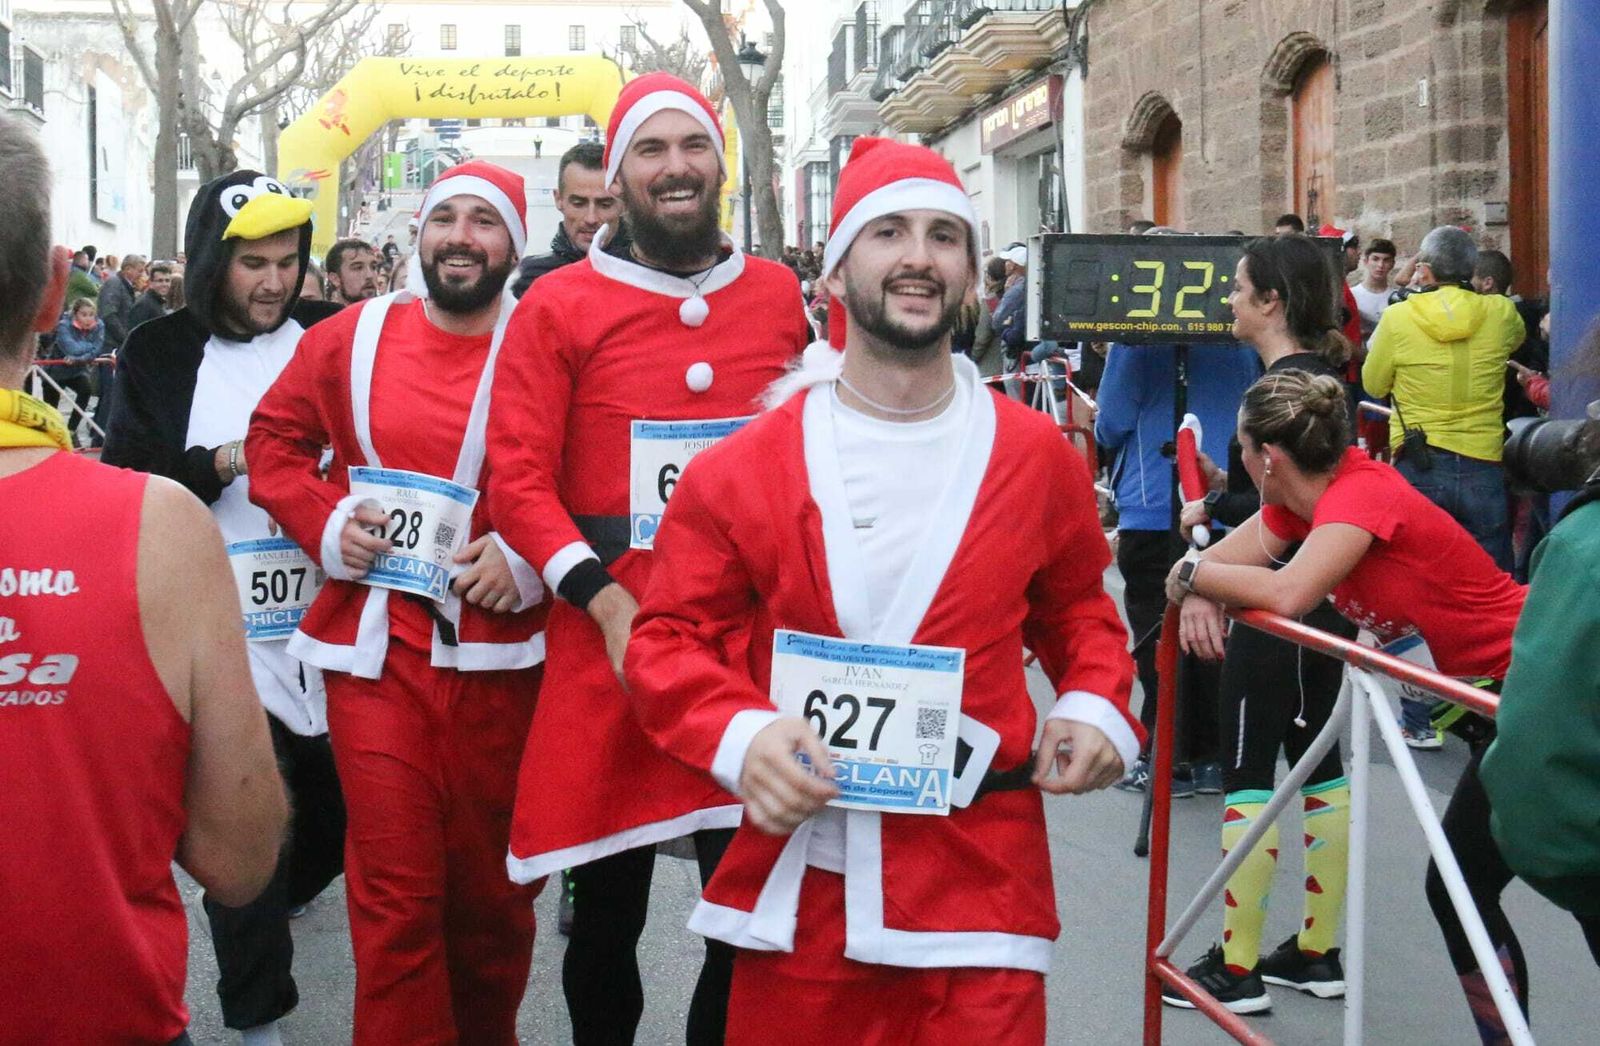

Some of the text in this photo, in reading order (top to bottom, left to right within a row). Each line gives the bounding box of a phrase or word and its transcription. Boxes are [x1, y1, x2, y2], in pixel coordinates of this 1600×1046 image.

[400, 62, 576, 81] Vive el deporte
[251, 567, 307, 606] 507
[802, 689, 897, 752] 627
